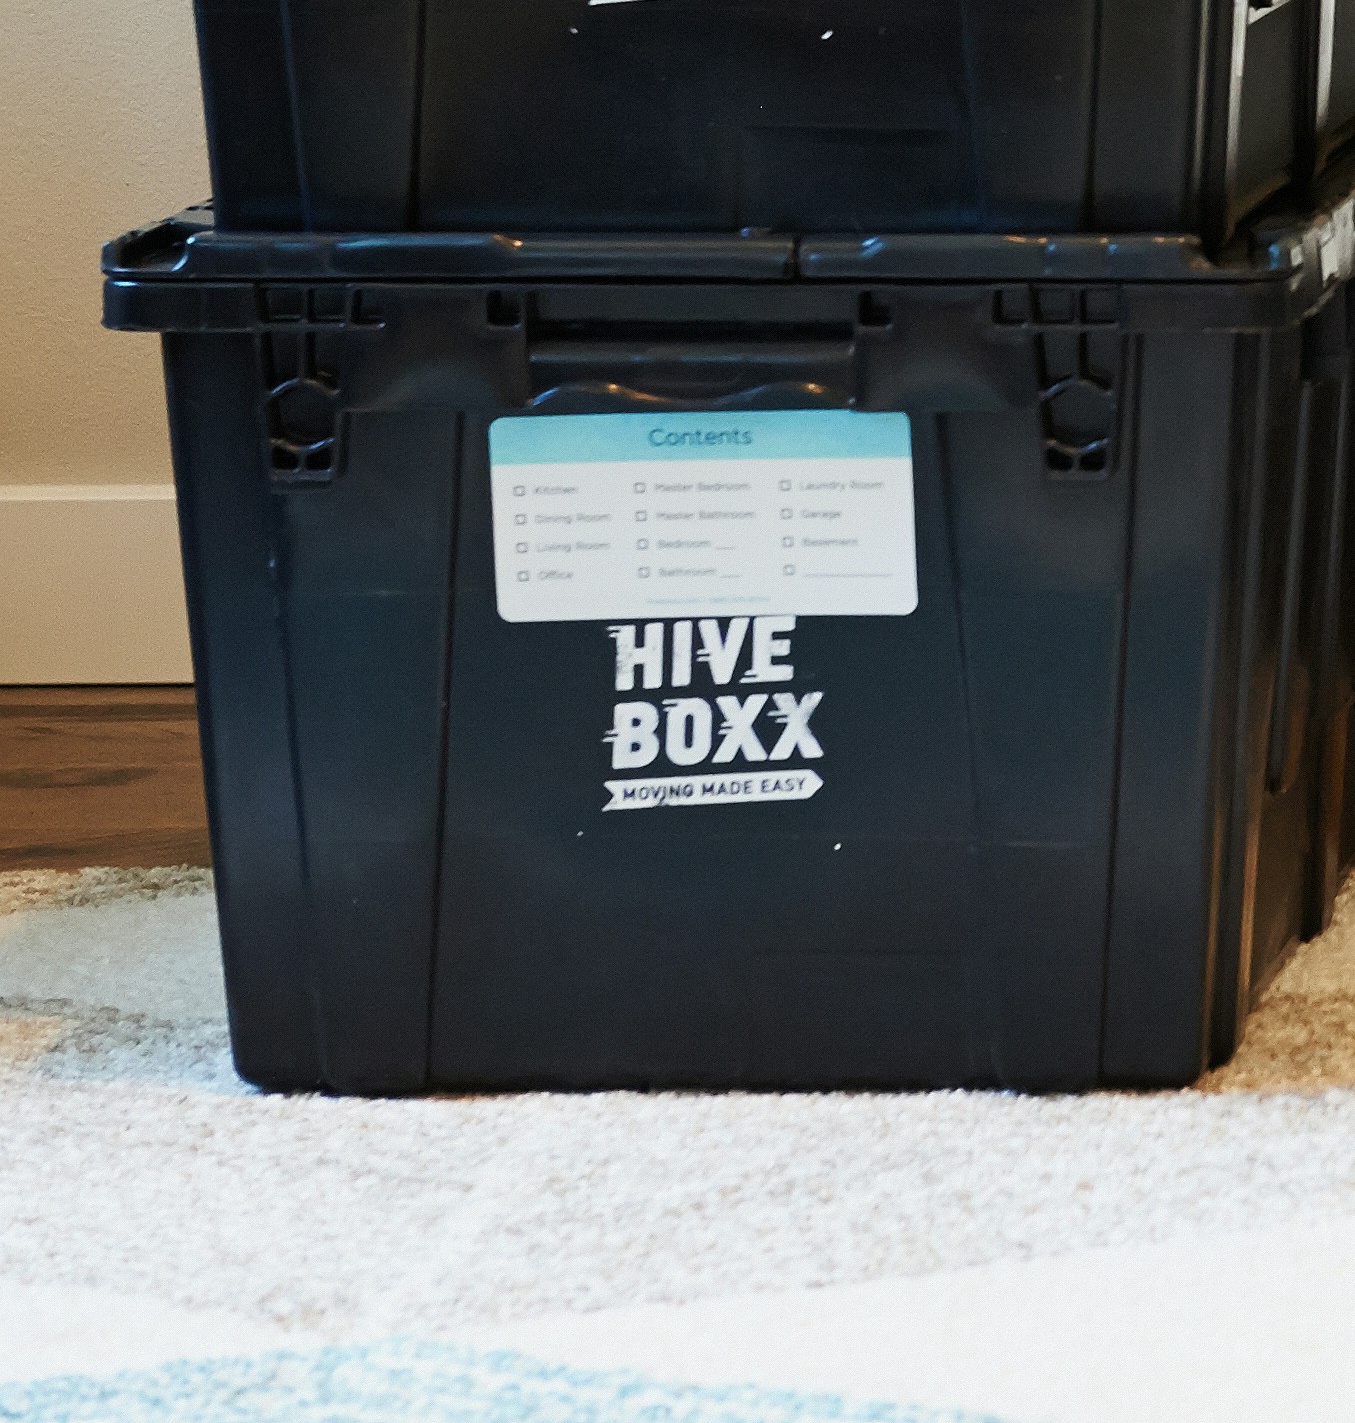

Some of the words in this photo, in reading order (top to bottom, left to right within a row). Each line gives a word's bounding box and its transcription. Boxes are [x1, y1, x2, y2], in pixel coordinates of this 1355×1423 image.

[648, 428, 752, 446] Contents
[533, 486, 577, 494] Kitchen
[654, 484, 693, 492] Master
[696, 482, 751, 491] Bedroom
[800, 481, 846, 492] Laundry
[849, 480, 884, 490] Room
[535, 514, 574, 525] Dining
[576, 513, 610, 522] Room
[656, 512, 694, 520] Master
[698, 510, 754, 520] Bathroom
[537, 544, 572, 553] Living
[575, 541, 610, 550] Room
[657, 540, 711, 549] Bedroom
[538, 570, 573, 580] Office
[658, 568, 716, 577] Bathroom
[607, 616, 796, 691] HIVE
[602, 692, 824, 769] BOXX
[623, 785, 694, 799] MOVING
[702, 780, 752, 796] MADE
[761, 778, 806, 792] EASY
